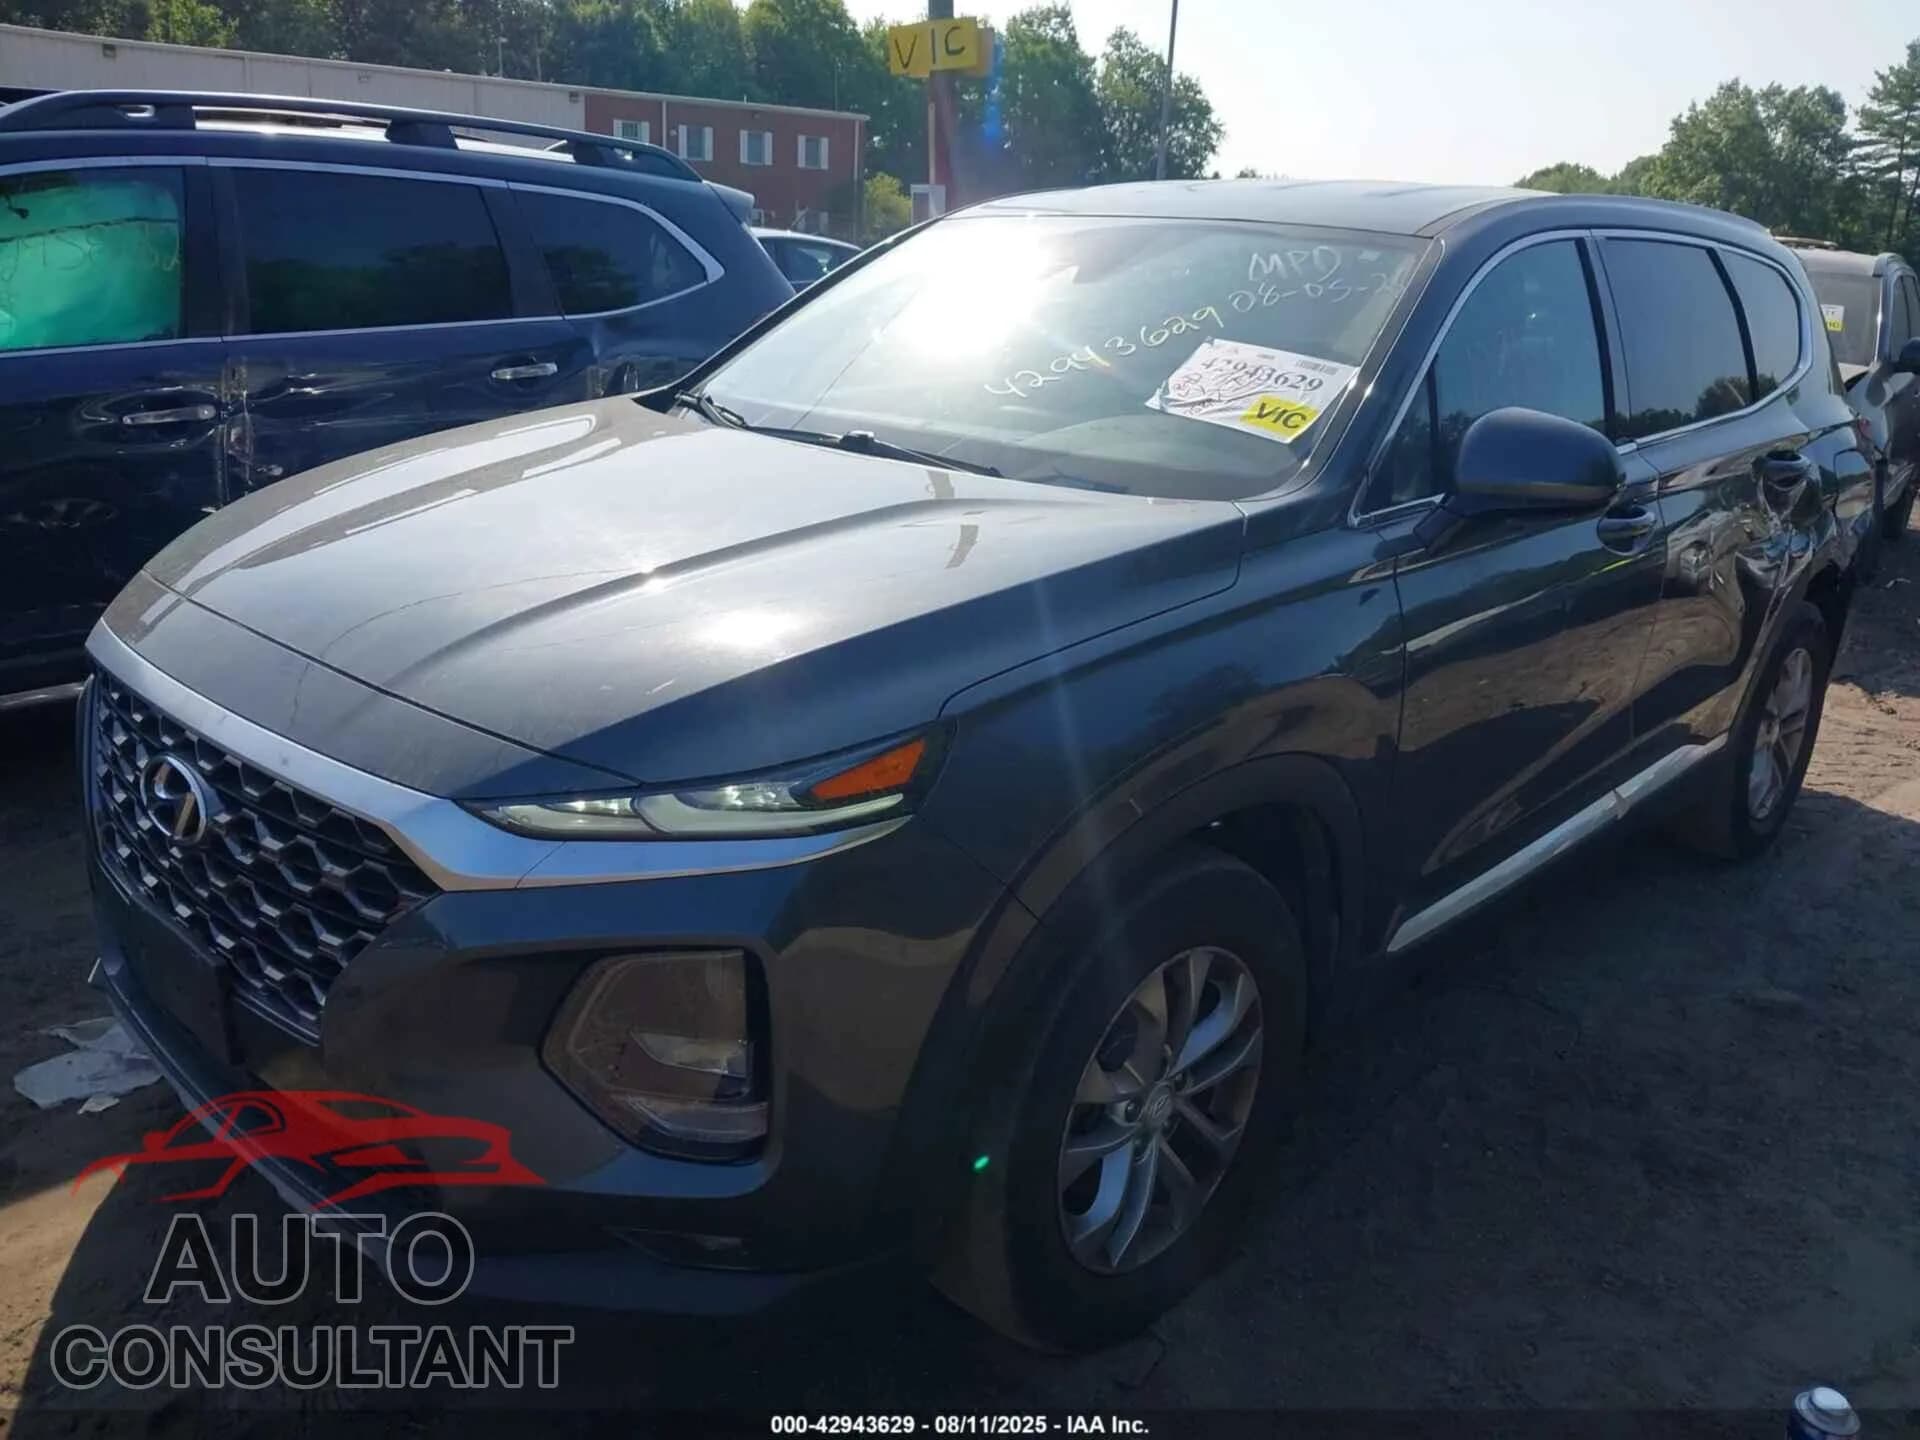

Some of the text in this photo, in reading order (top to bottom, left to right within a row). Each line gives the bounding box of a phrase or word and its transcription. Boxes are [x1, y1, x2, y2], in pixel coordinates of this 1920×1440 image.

[894, 26, 966, 69] VIC
[1248, 245, 1342, 283] MPD
[983, 306, 1224, 398] 42943629
[1255, 402, 1307, 429] VIC
